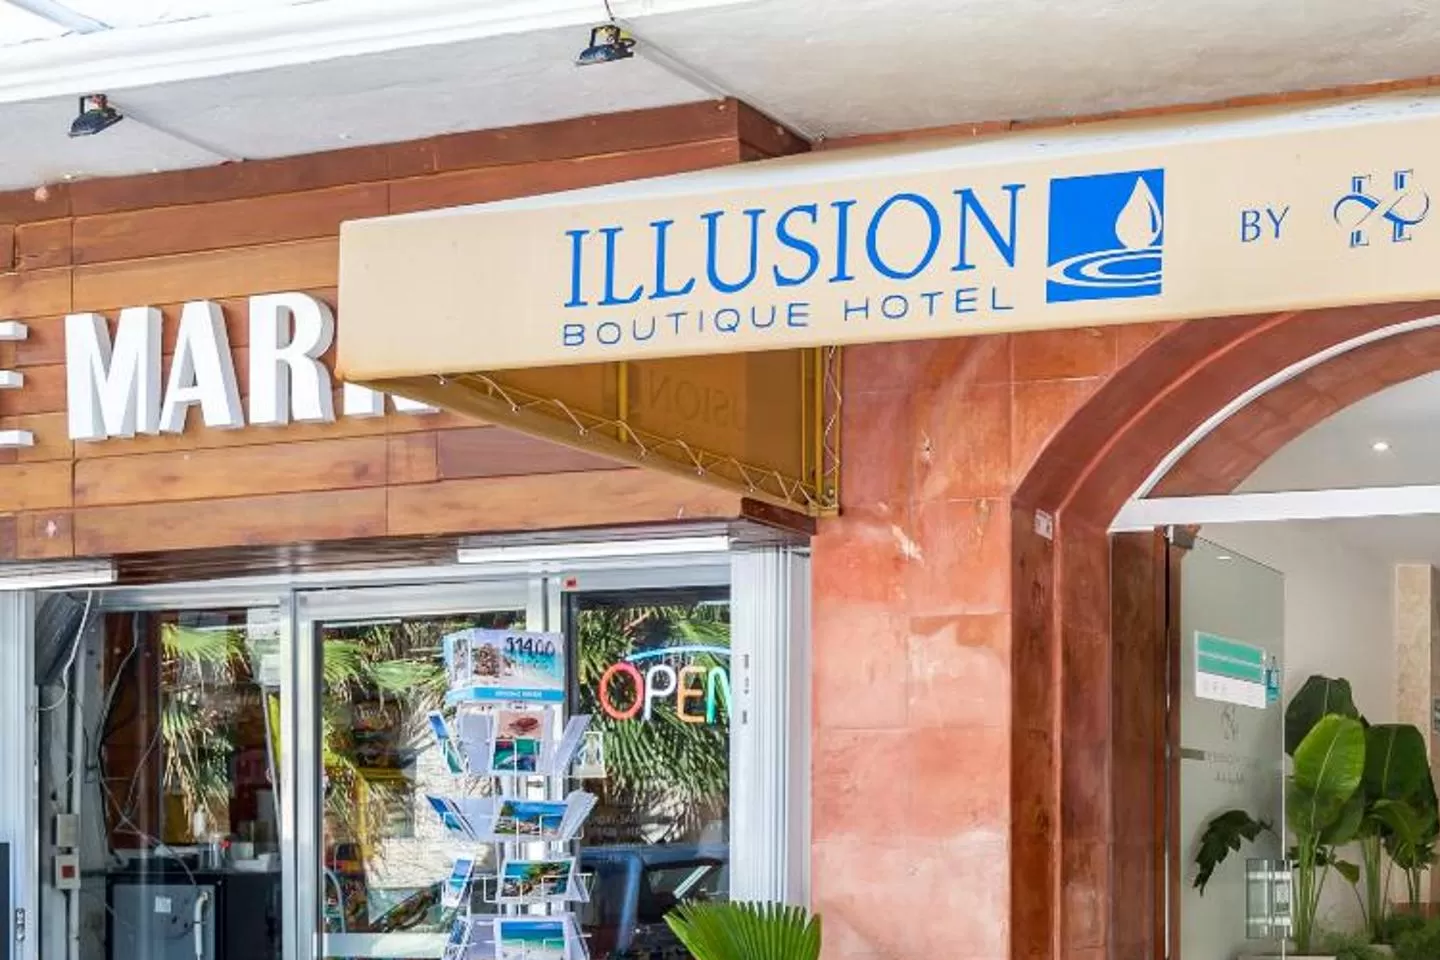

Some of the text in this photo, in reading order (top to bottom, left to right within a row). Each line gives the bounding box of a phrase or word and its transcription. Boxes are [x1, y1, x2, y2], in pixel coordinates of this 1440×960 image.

[564, 183, 1026, 308] ILLUSION
[1240, 205, 1290, 242] BY
[563, 286, 1014, 347] BOUTIQUE HOTEL
